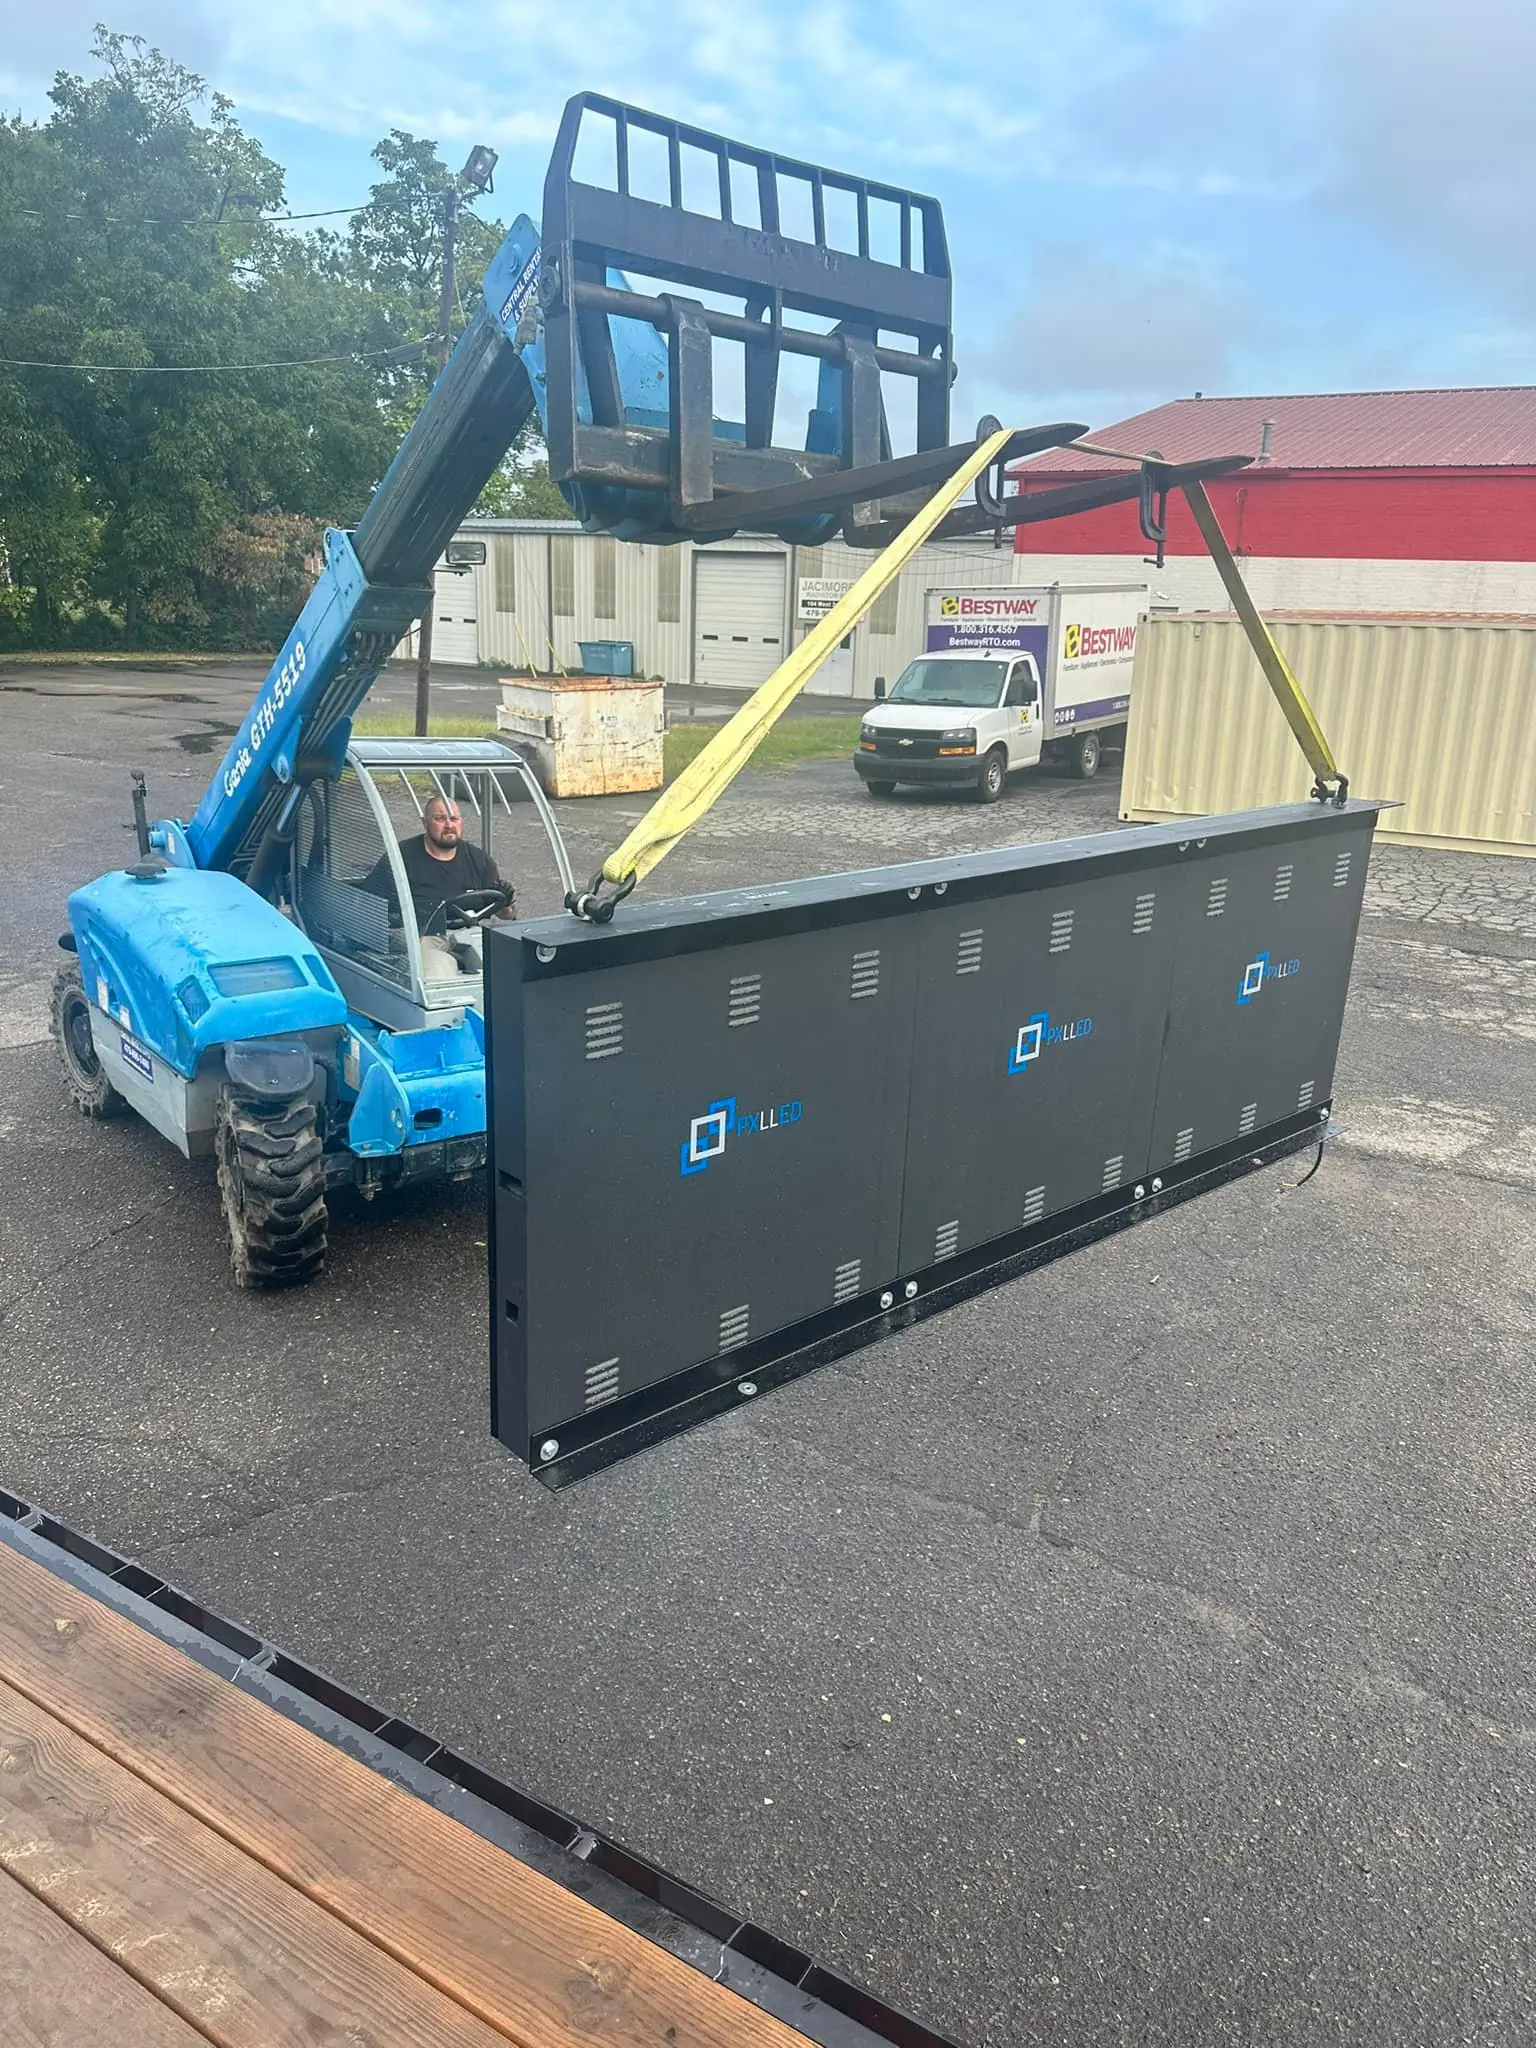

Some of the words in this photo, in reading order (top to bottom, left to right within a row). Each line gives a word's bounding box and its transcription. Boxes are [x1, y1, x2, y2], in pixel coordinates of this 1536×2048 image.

[501, 280, 525, 322] CENTRAL
[514, 310, 521, 321] &
[518, 275, 540, 313] SUPPLY
[960, 599, 1037, 614] BESTWAY
[949, 637, 1021, 648] BestwayRTO.com
[953, 625, 1018, 634] 1.800.316.4567
[1080, 626, 1137, 656] BESTWAY
[223, 746, 252, 798] Genie
[250, 641, 307, 751] GTH-5519
[1264, 958, 1301, 980] PXLLED
[1046, 1018, 1093, 1045] PXLLED
[737, 1100, 803, 1137] PXLLED
